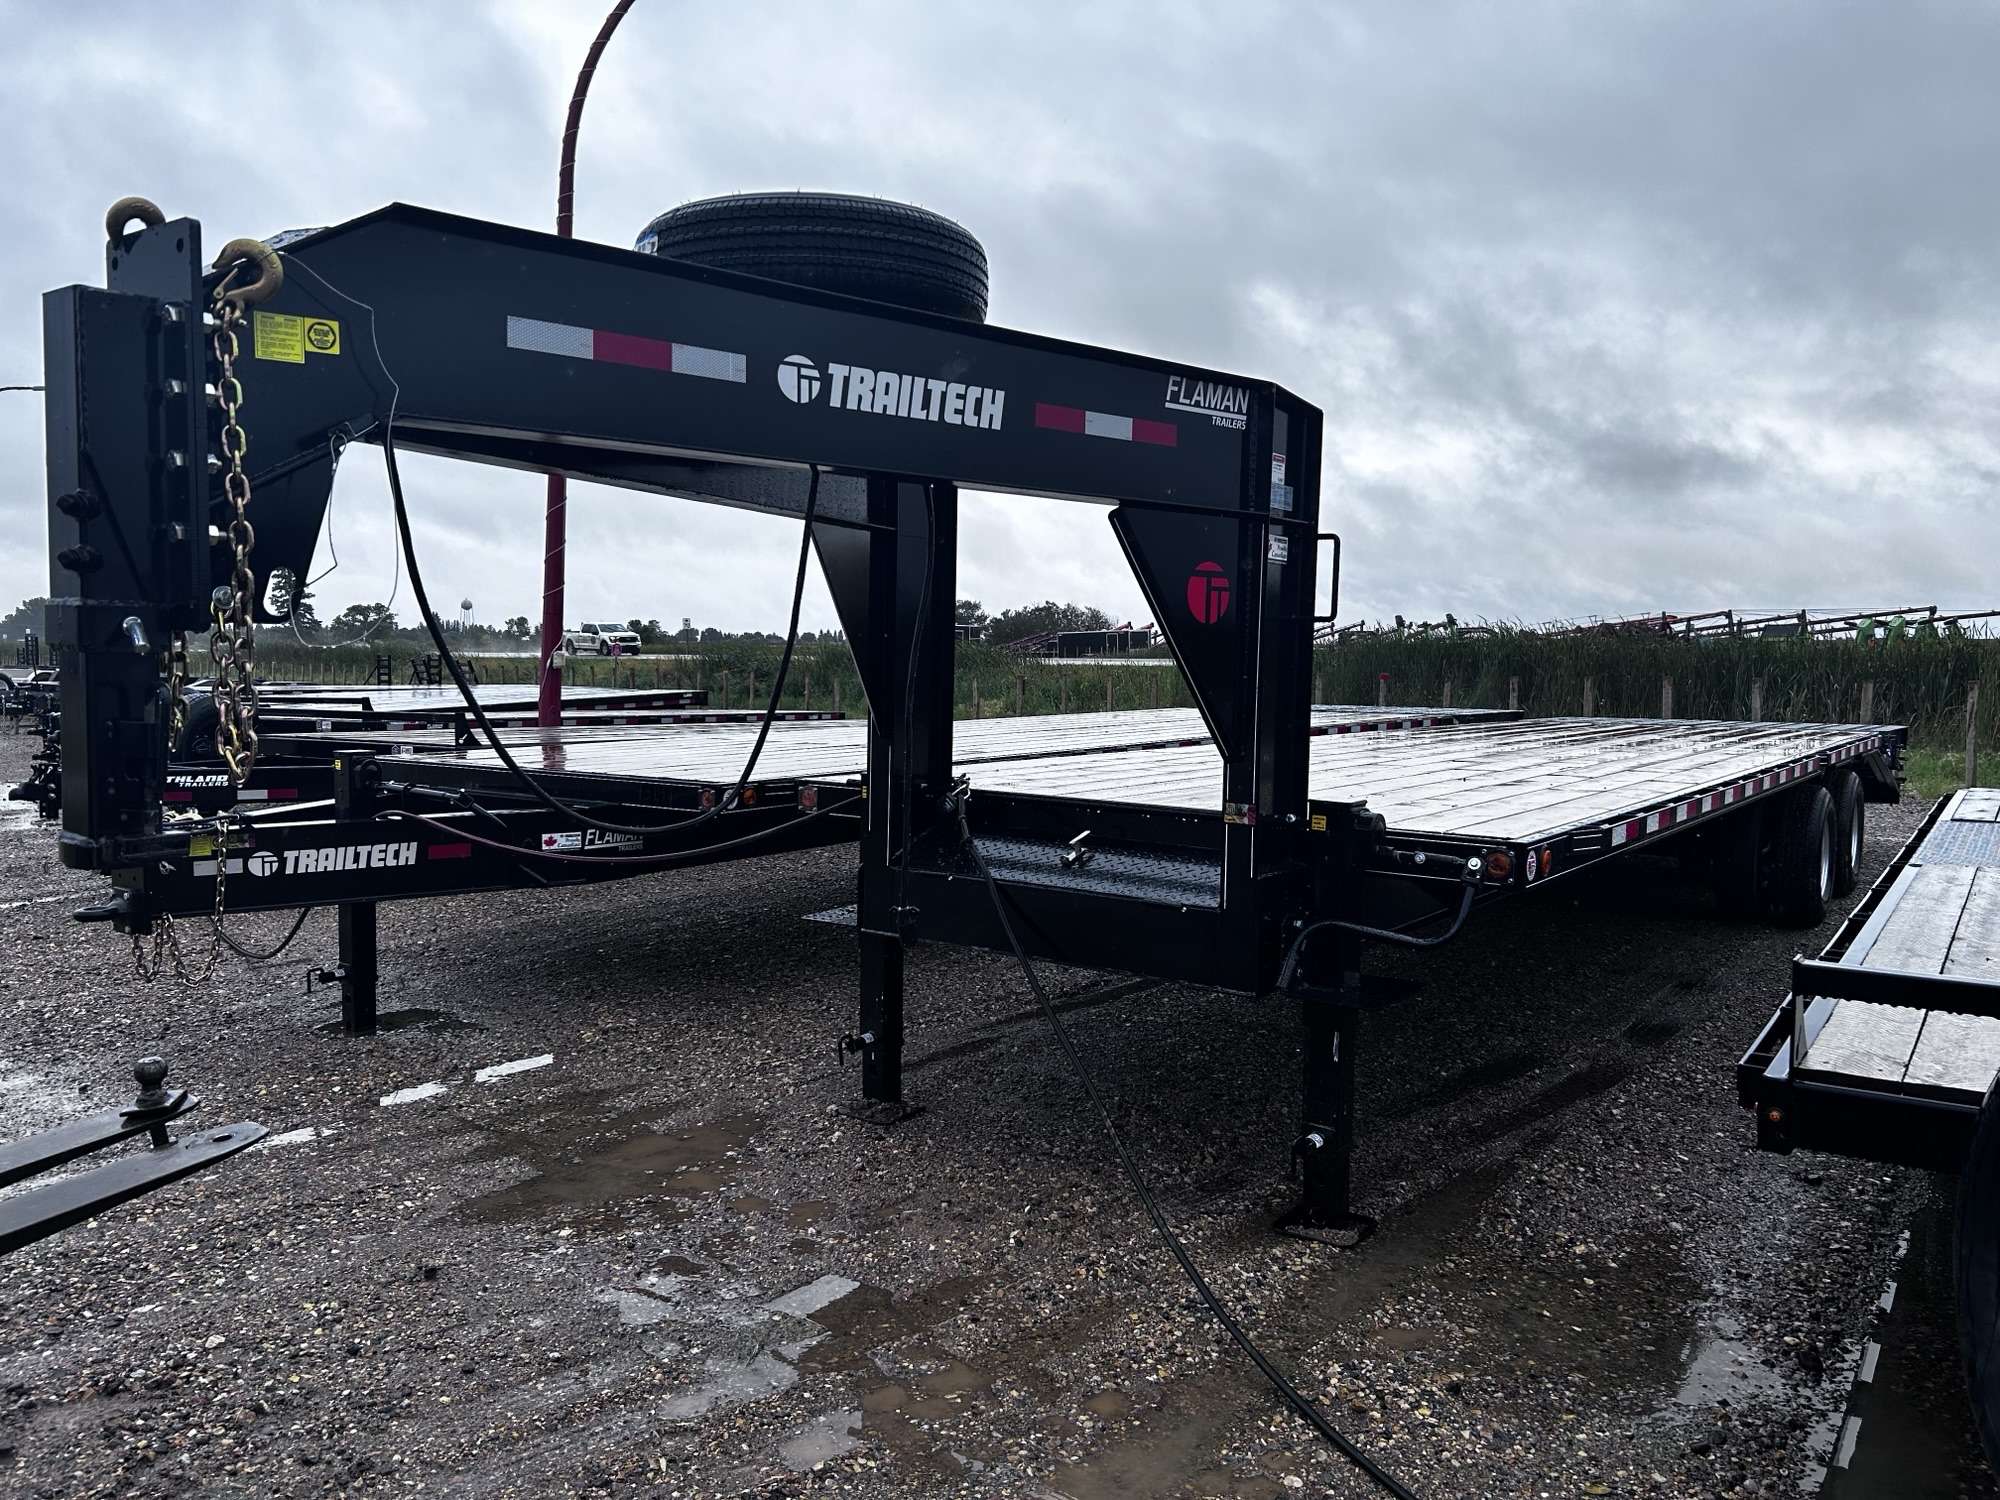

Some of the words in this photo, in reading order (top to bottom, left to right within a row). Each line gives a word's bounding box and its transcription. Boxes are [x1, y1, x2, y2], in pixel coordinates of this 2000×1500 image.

[828, 362, 1005, 430] TRAILTECH
[1166, 375, 1250, 414] FLAMAN
[1211, 415, 1247, 430] TRAILERS
[283, 841, 418, 875] TRAILTECH
